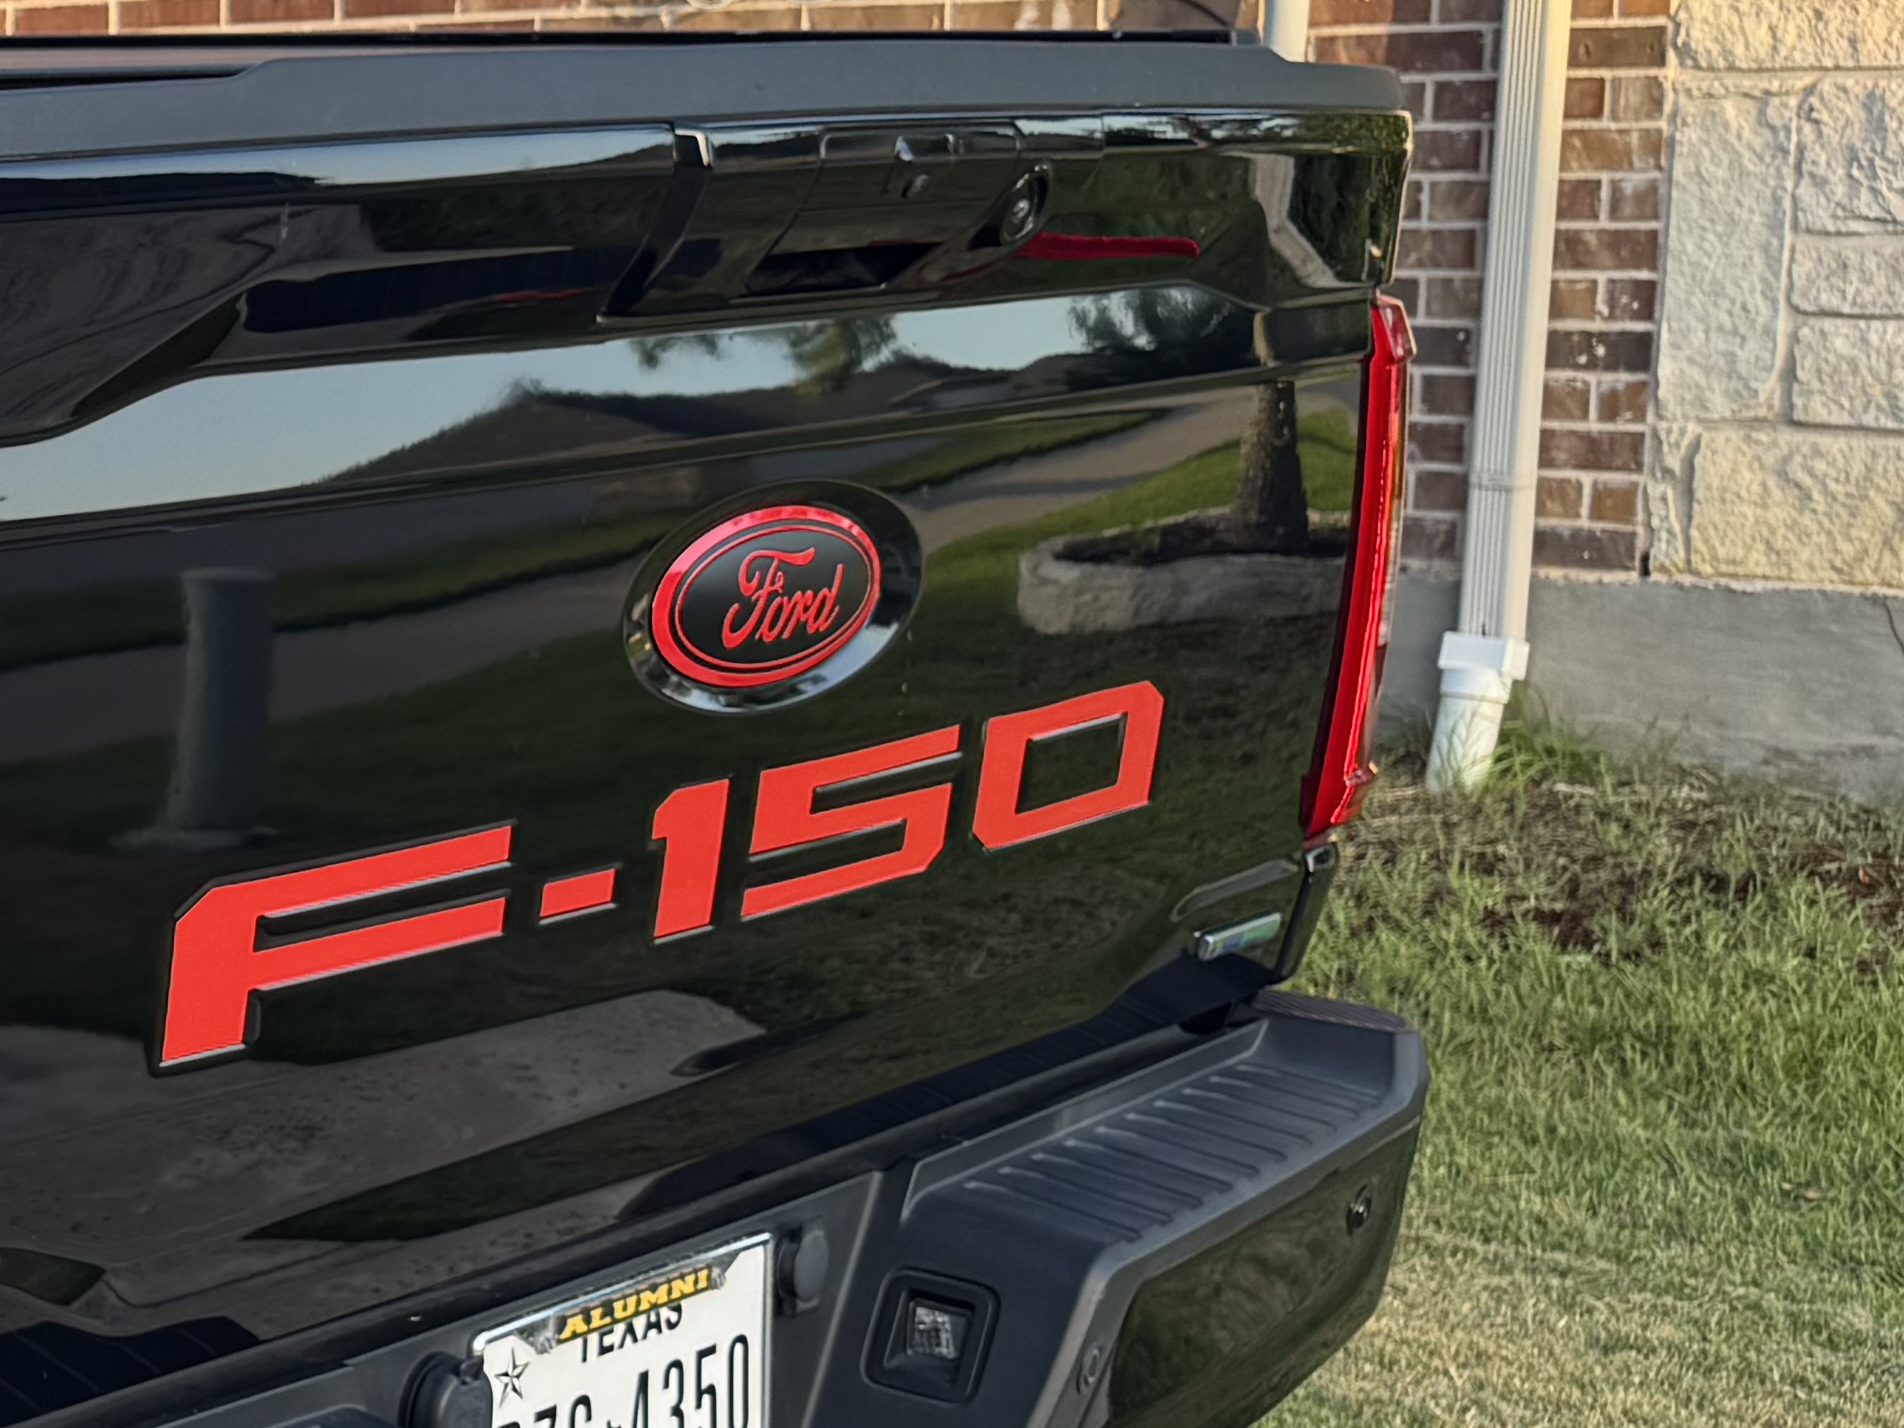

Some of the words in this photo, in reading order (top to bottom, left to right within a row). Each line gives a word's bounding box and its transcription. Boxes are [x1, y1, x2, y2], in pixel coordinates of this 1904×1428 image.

[721, 546, 845, 649] Ford
[156, 679, 1164, 1069] F-150
[558, 1267, 710, 1341] ALUMNI
